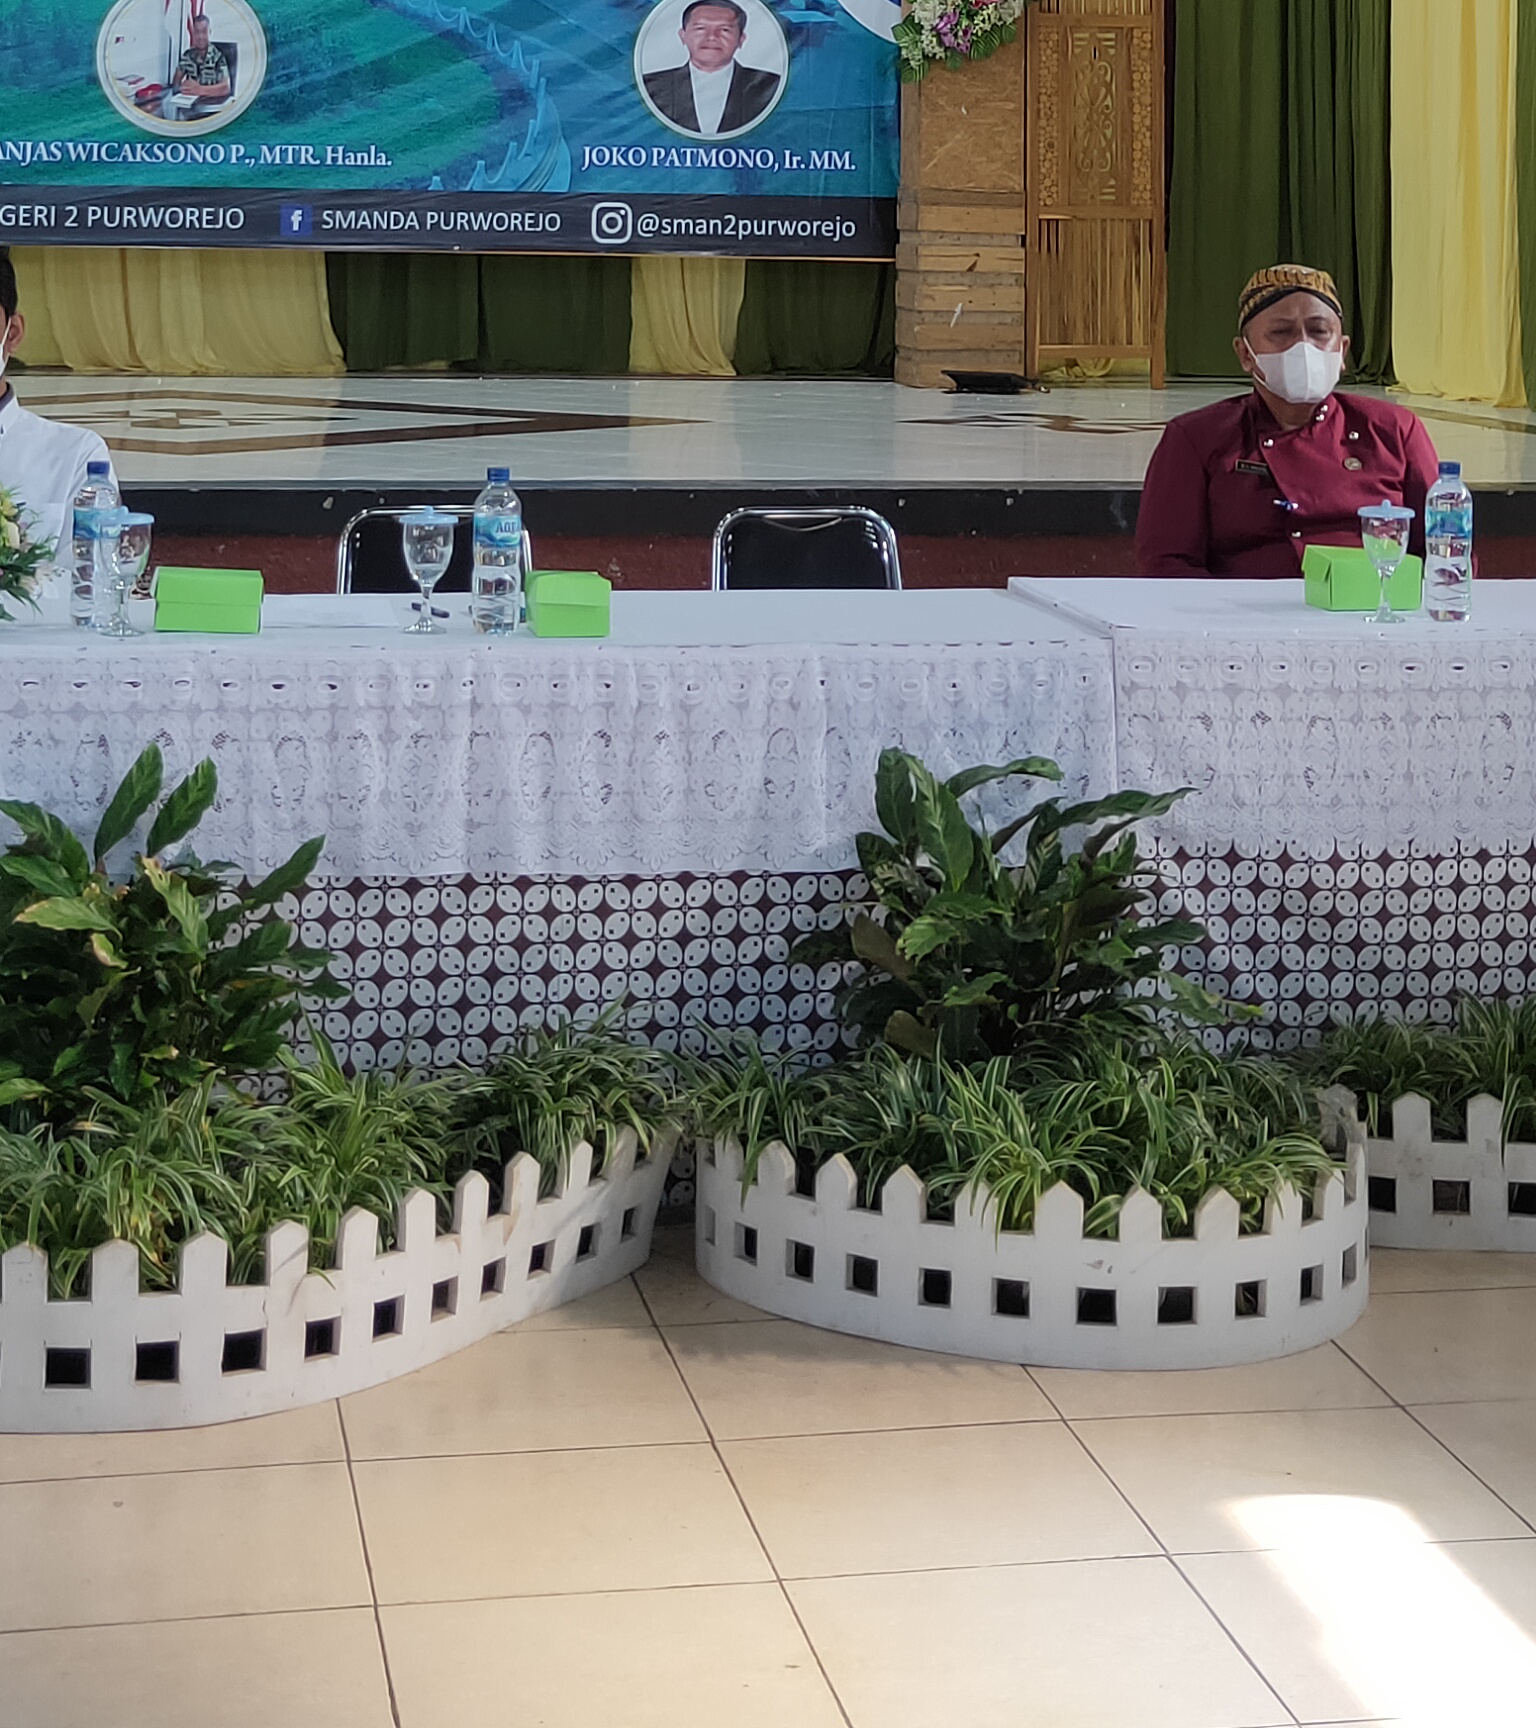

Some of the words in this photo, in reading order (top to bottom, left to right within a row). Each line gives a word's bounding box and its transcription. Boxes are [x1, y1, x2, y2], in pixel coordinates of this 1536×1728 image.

[65, 142, 226, 164] WICAKSONO
[230, 144, 256, 168] P.,
[260, 144, 321, 166] MTR.
[325, 145, 393, 167] Hanla.
[581, 146, 647, 171] JOKO
[651, 147, 780, 172] PATMONO,
[784, 149, 806, 170] Ir.
[809, 150, 857, 170] MM.
[64, 205, 80, 228] 2
[87, 206, 246, 230] PURWOREJO
[321, 209, 420, 232] SMANDA
[426, 211, 562, 233] PURWOREJO
[637, 212, 857, 241] @sman2purworejo
